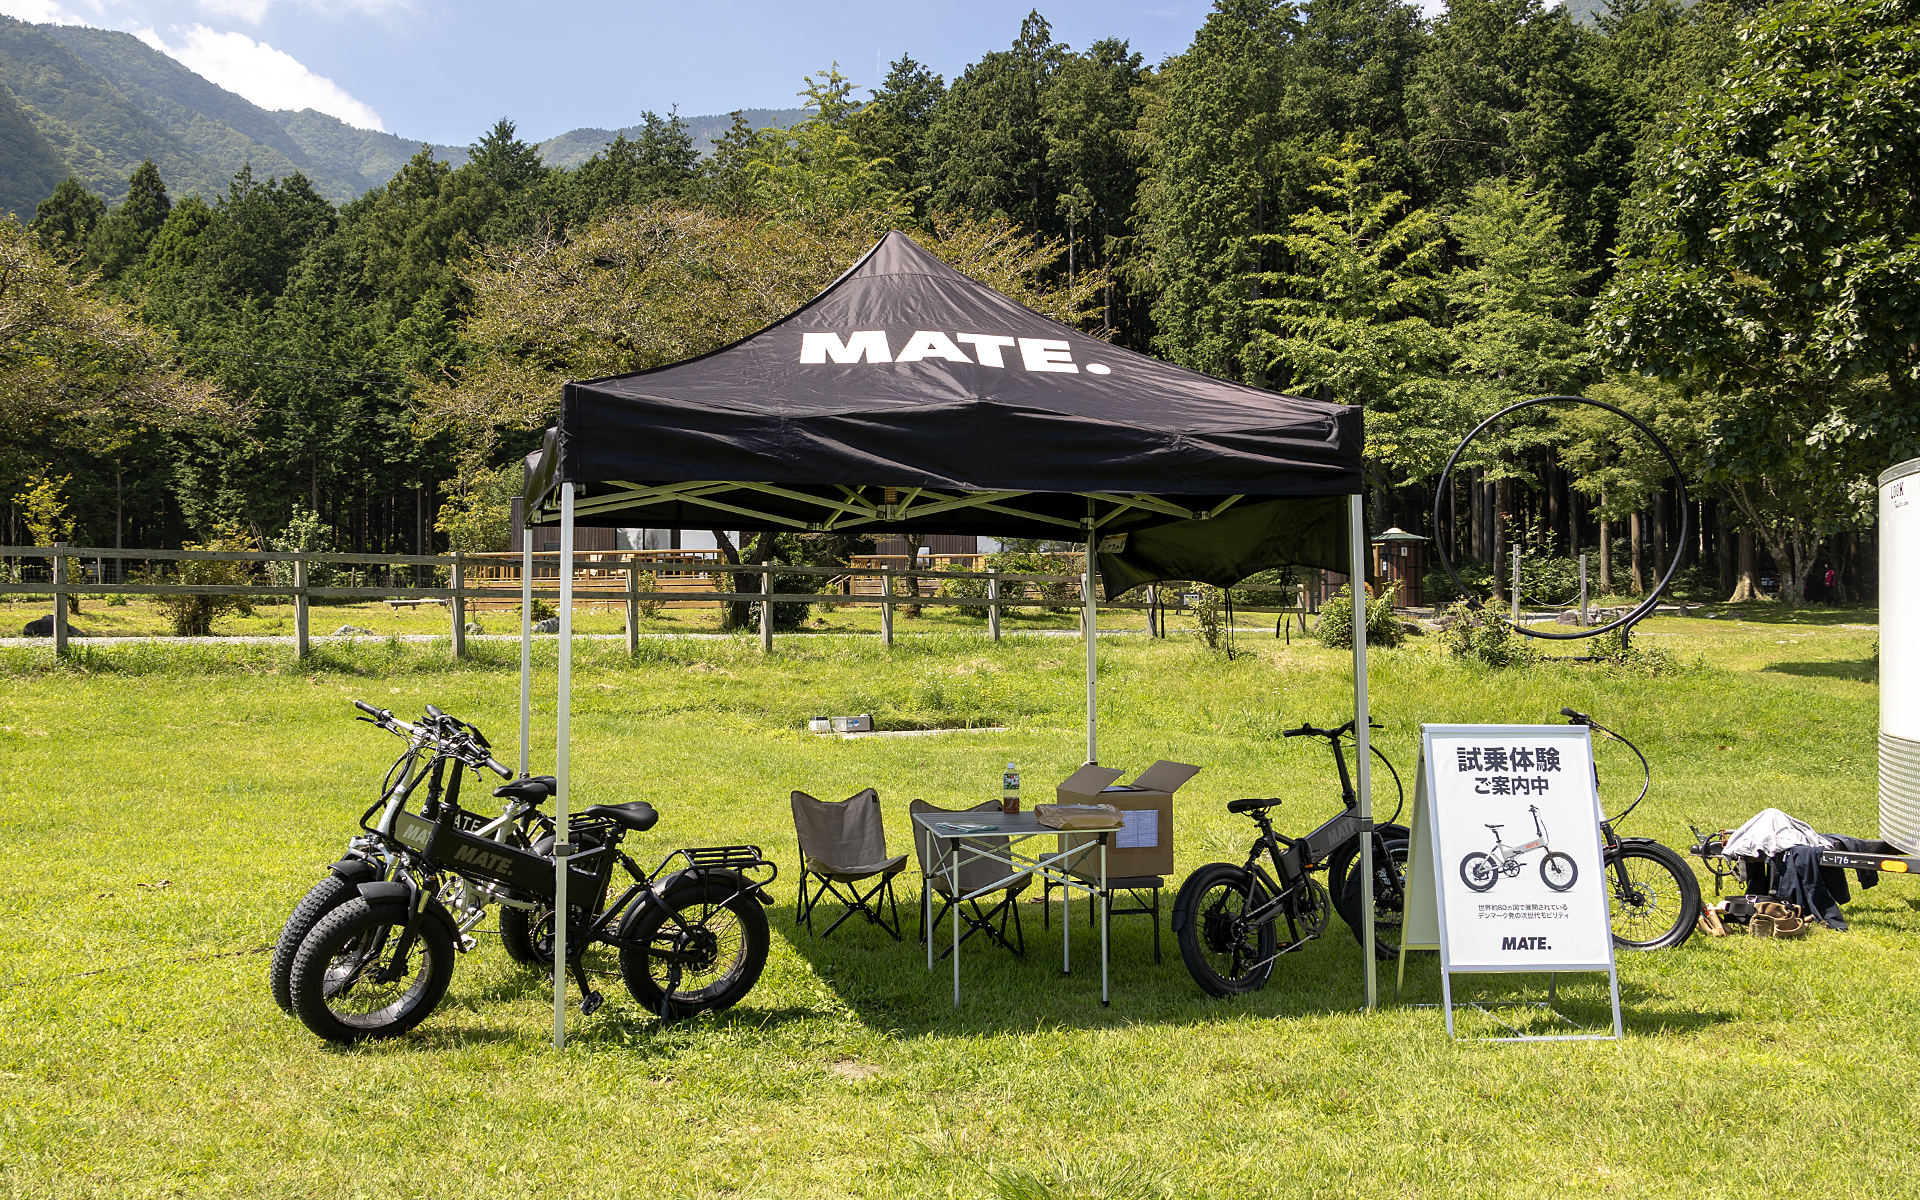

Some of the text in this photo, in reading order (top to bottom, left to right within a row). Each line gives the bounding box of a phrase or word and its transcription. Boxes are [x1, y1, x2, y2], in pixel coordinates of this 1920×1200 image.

[799, 330, 1112, 375] MATE.
[1457, 746, 1561, 772] 試乗体験
[1475, 776, 1549, 795] ご案内中
[454, 845, 513, 876] MATE.
[1501, 936, 1552, 950] MATE.
